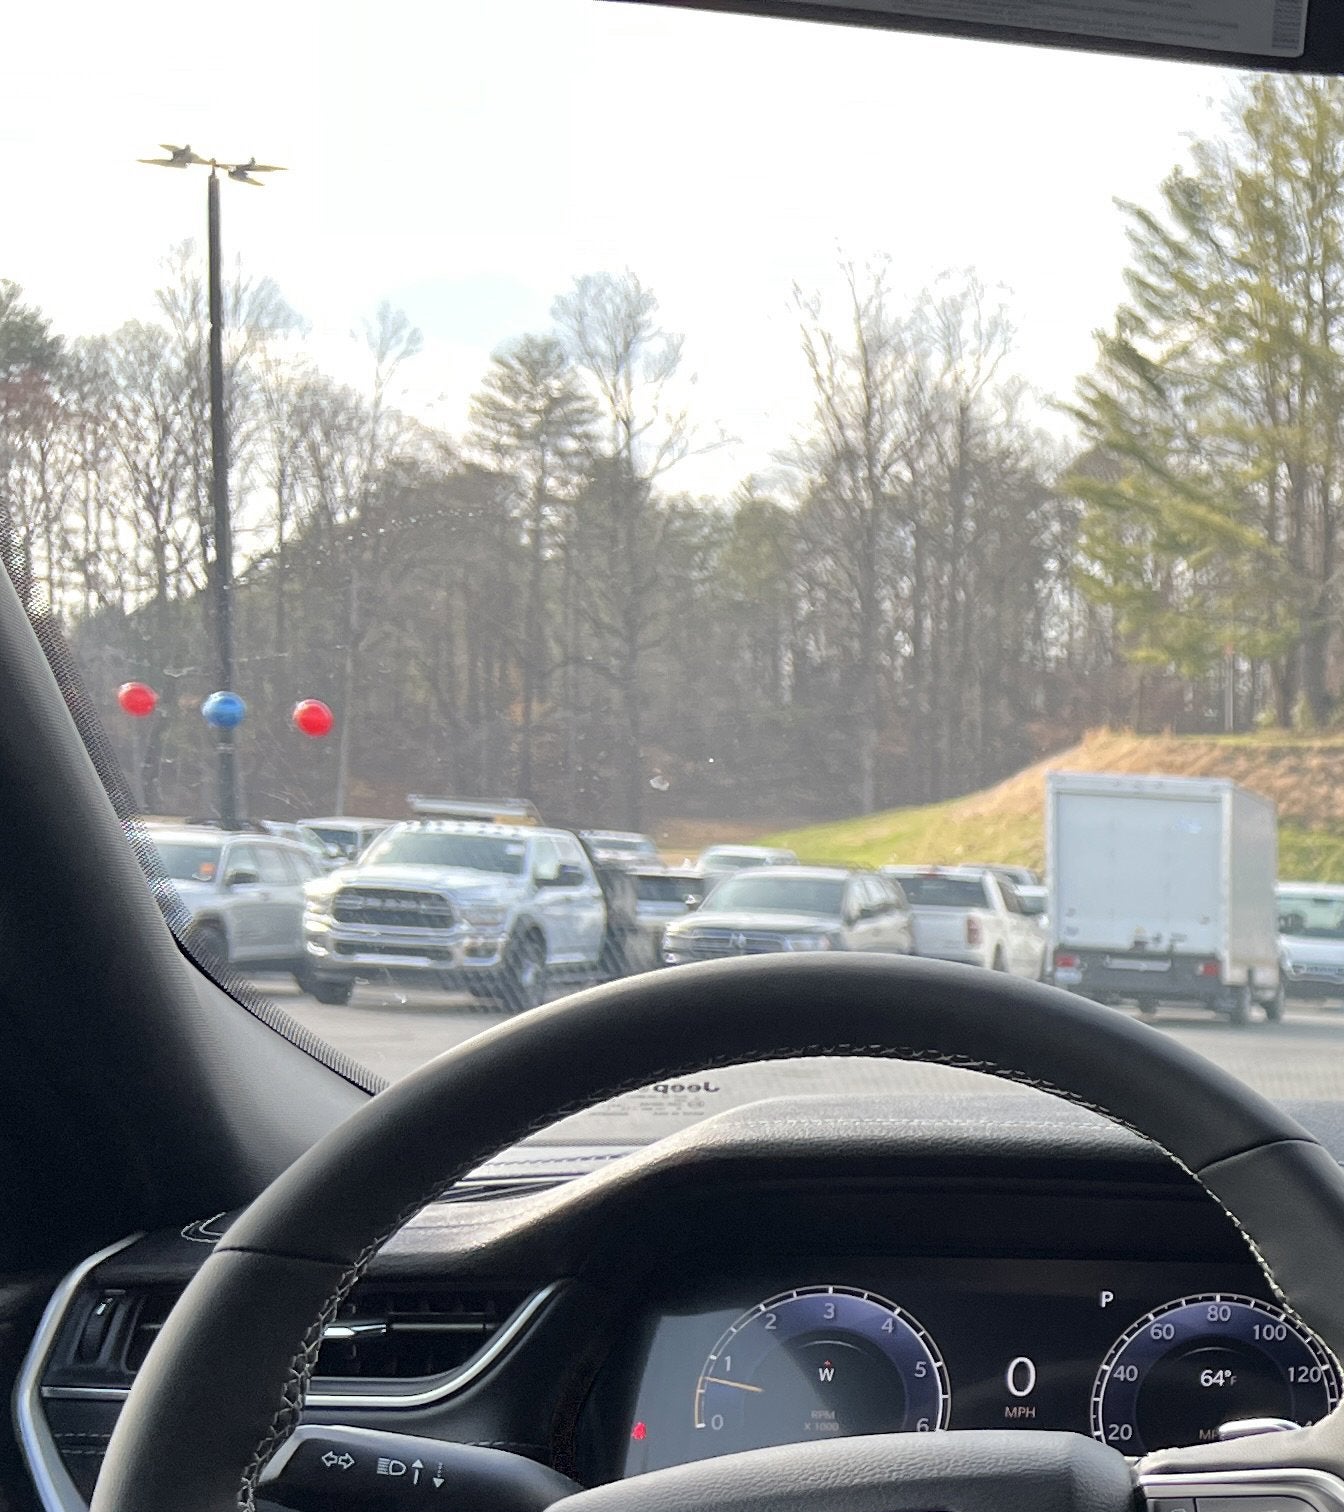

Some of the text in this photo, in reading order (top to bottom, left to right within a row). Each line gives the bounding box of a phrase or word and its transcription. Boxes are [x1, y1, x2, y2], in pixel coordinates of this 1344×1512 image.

[1101, 1291, 1114, 1308] P
[822, 1302, 836, 1320] 3
[1206, 1305, 1232, 1322] 80
[764, 1312, 777, 1330] 2
[880, 1317, 895, 1334] 4
[1149, 1323, 1175, 1340] 60
[1252, 1323, 1287, 1341] 100
[723, 1356, 732, 1372] 1
[914, 1360, 927, 1378] 5
[818, 1367, 835, 1382] W
[1006, 1356, 1037, 1397] 0
[1113, 1364, 1139, 1382] 40
[1287, 1365, 1323, 1384] 120
[810, 1410, 836, 1420] RPM
[1004, 1405, 1036, 1419] MPH
[711, 1414, 724, 1431] 0
[814, 1422, 840, 1431] 1000
[916, 1417, 930, 1432] 6
[1108, 1423, 1133, 1441] 20
